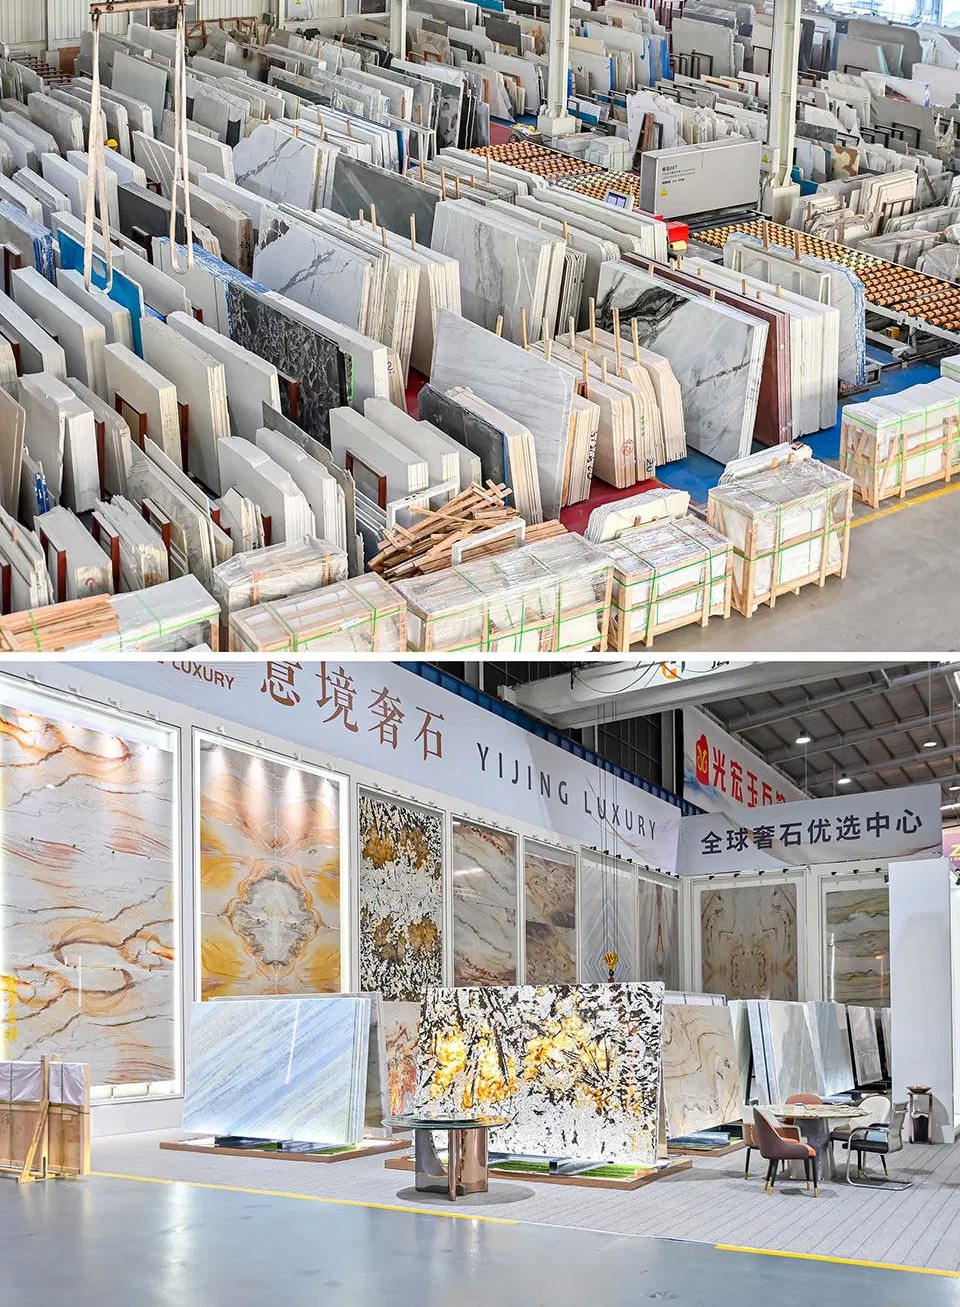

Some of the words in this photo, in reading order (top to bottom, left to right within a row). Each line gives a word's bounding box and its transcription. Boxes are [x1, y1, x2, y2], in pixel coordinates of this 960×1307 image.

[477, 742, 568, 805] YIJING
[584, 790, 656, 840] LUXURY
[701, 809, 923, 855] 全球奢石优选中心
